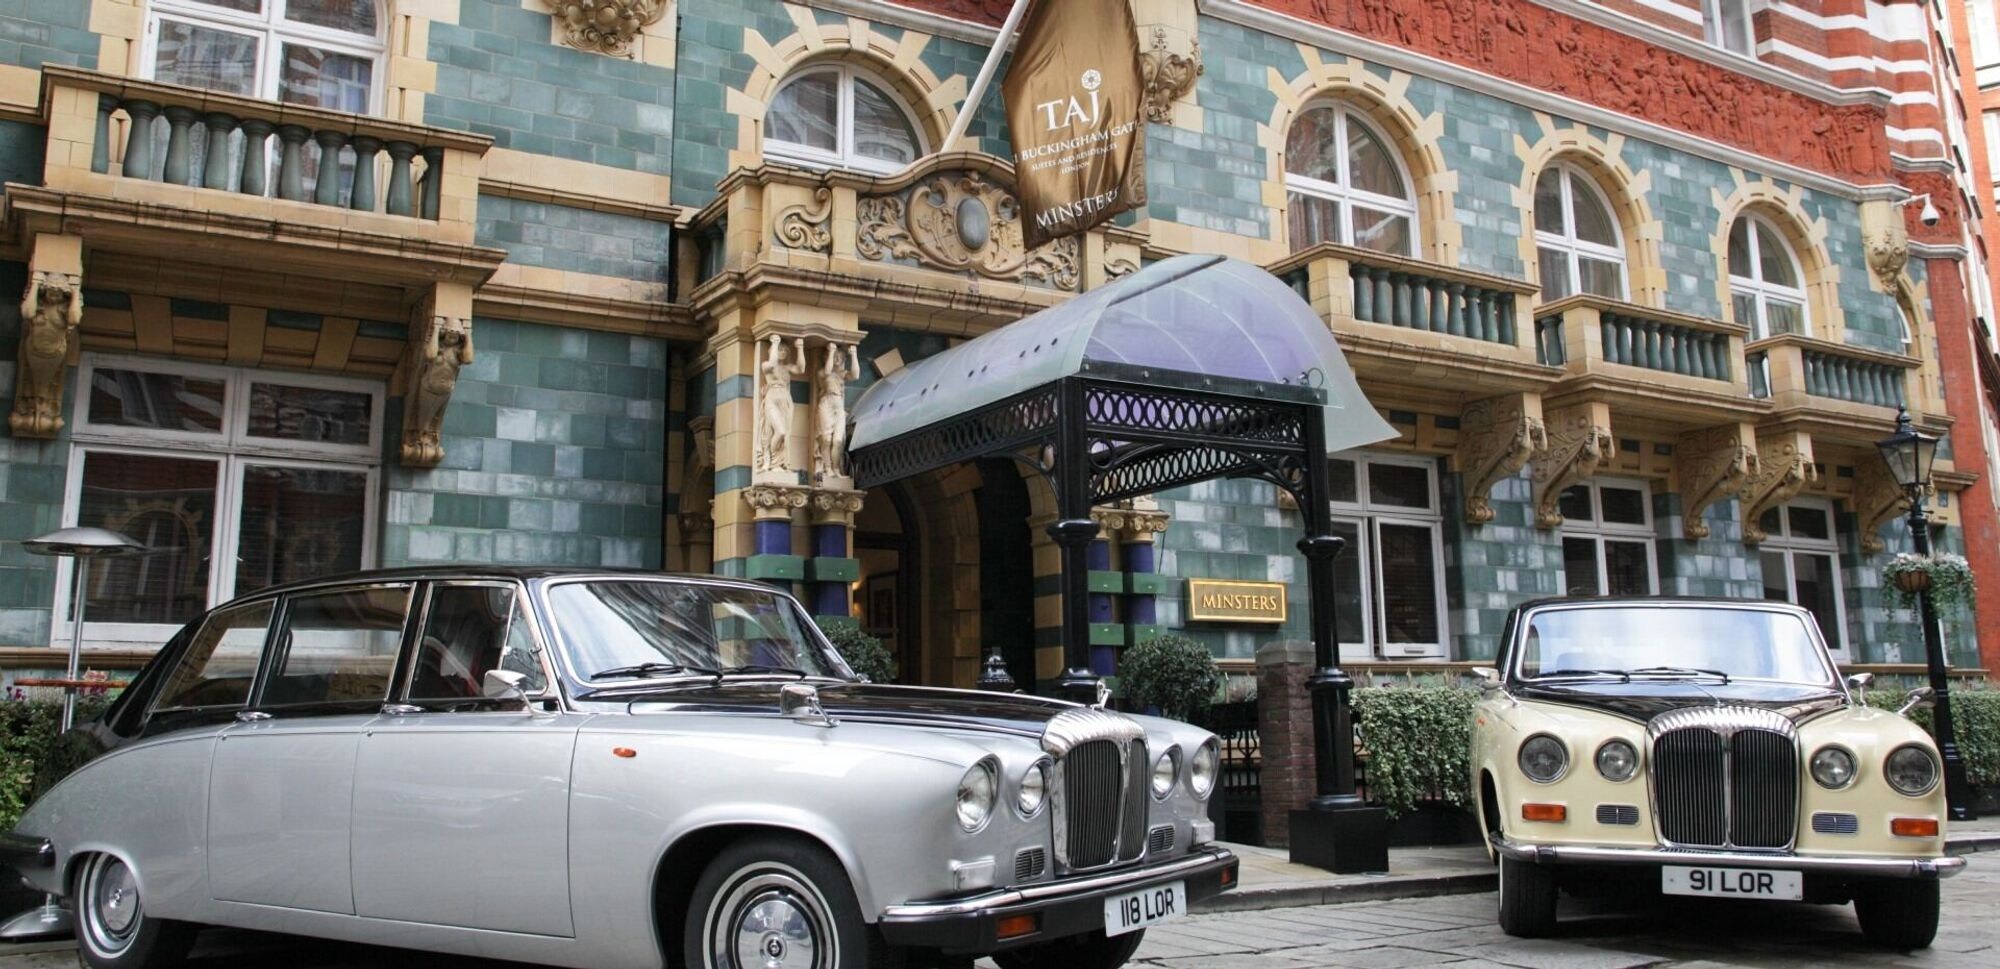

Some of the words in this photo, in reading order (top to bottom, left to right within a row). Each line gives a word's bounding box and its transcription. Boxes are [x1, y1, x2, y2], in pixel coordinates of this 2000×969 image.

[1037, 90, 1099, 131] TAJ
[1022, 130, 1109, 161] BUCKINGHAM
[1058, 155, 1075, 166] AND
[1061, 160, 1090, 175] LONDON
[1202, 594, 1277, 611] MINSTERS
[1690, 870, 1713, 892] 91
[1721, 871, 1774, 894] LOR
[1120, 896, 1141, 928] 118
[1144, 887, 1175, 921] LOR
